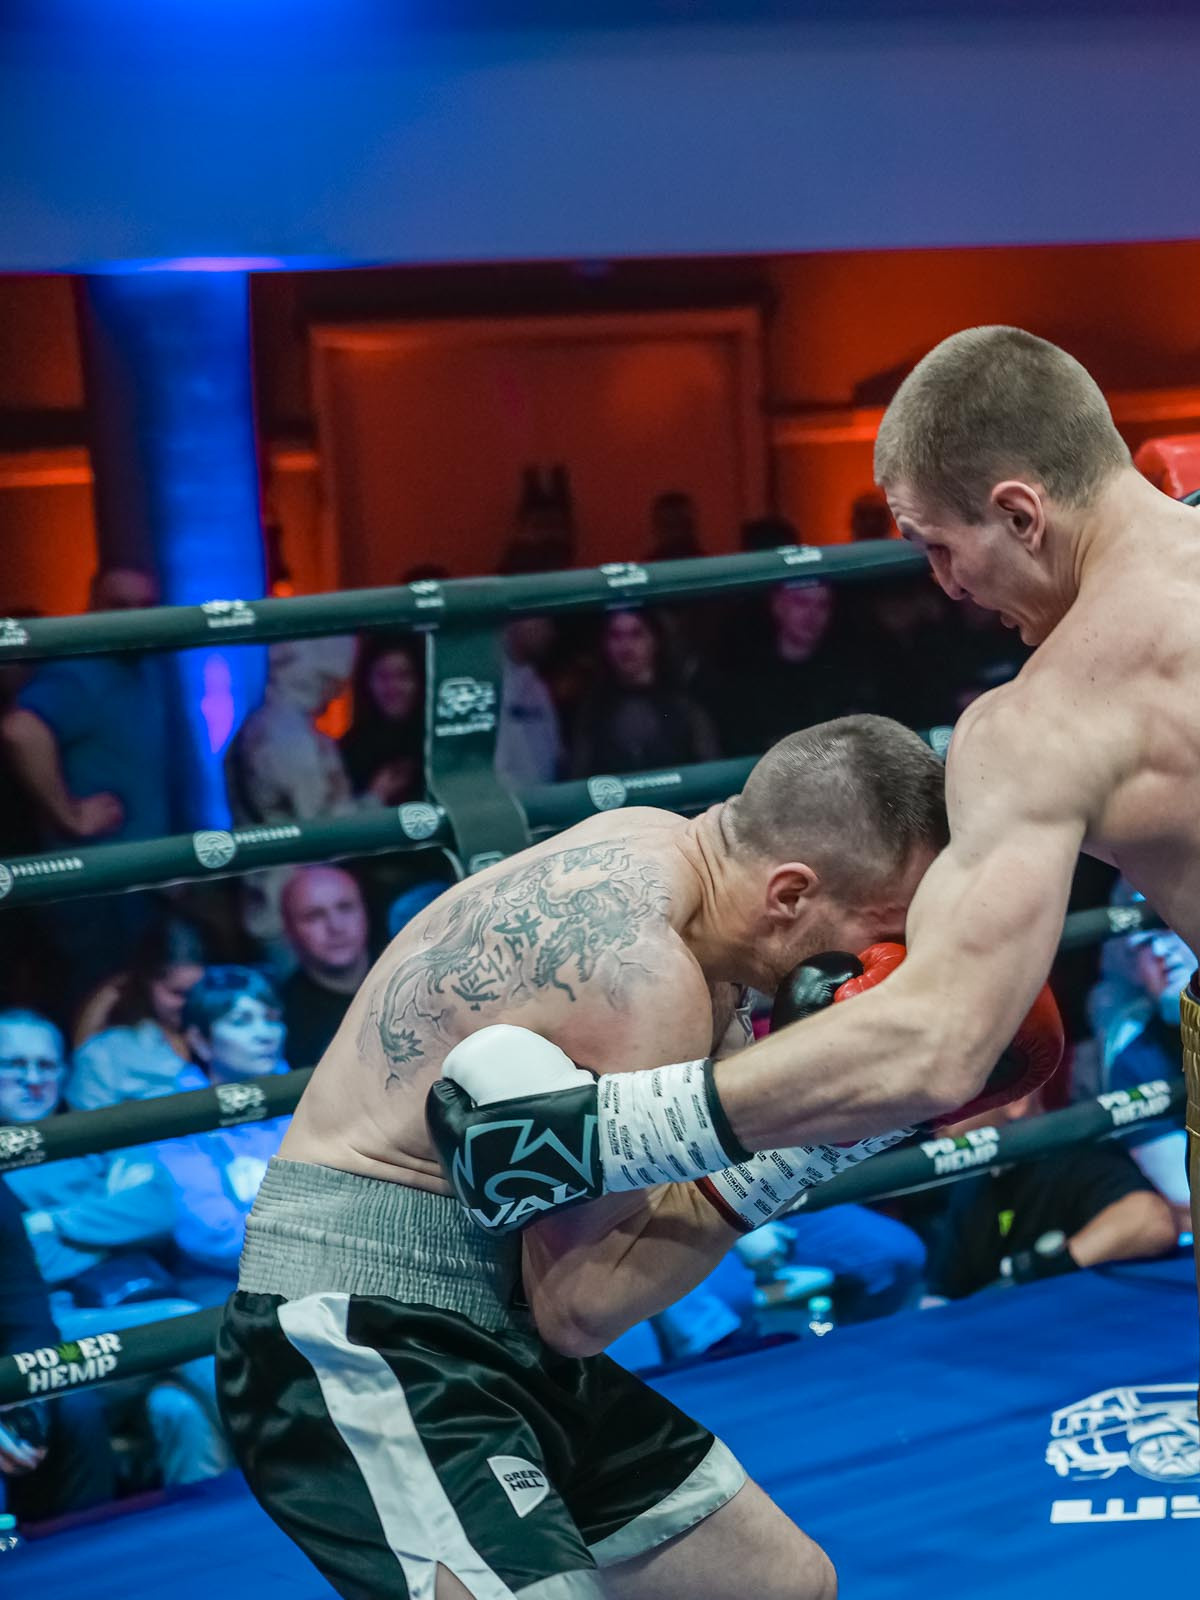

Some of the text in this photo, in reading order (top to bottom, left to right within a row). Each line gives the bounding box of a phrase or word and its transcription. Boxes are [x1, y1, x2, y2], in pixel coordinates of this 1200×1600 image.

[933, 1143, 1000, 1176] HEMP
[723, 1169, 749, 1199] ULTIMATUM
[27, 1354, 119, 1395] HEMP
[502, 1469, 543, 1483] GREEN
[509, 1478, 545, 1492] HILL
